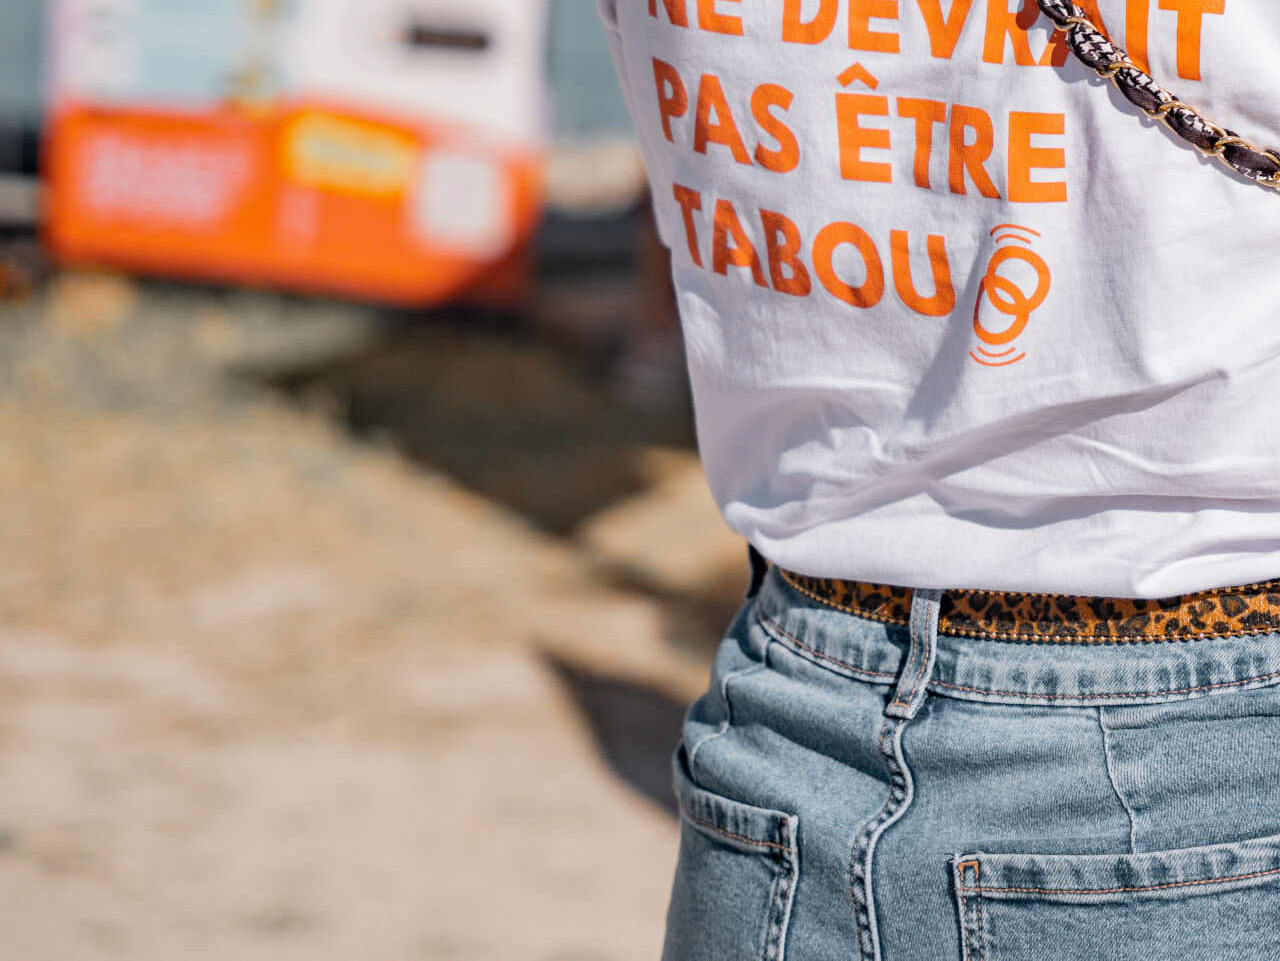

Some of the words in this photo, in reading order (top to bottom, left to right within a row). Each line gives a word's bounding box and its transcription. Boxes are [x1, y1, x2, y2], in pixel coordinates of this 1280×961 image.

[652, 57, 801, 173] PAS
[836, 61, 1068, 203] ÊTRE
[672, 183, 956, 317] TABOU
